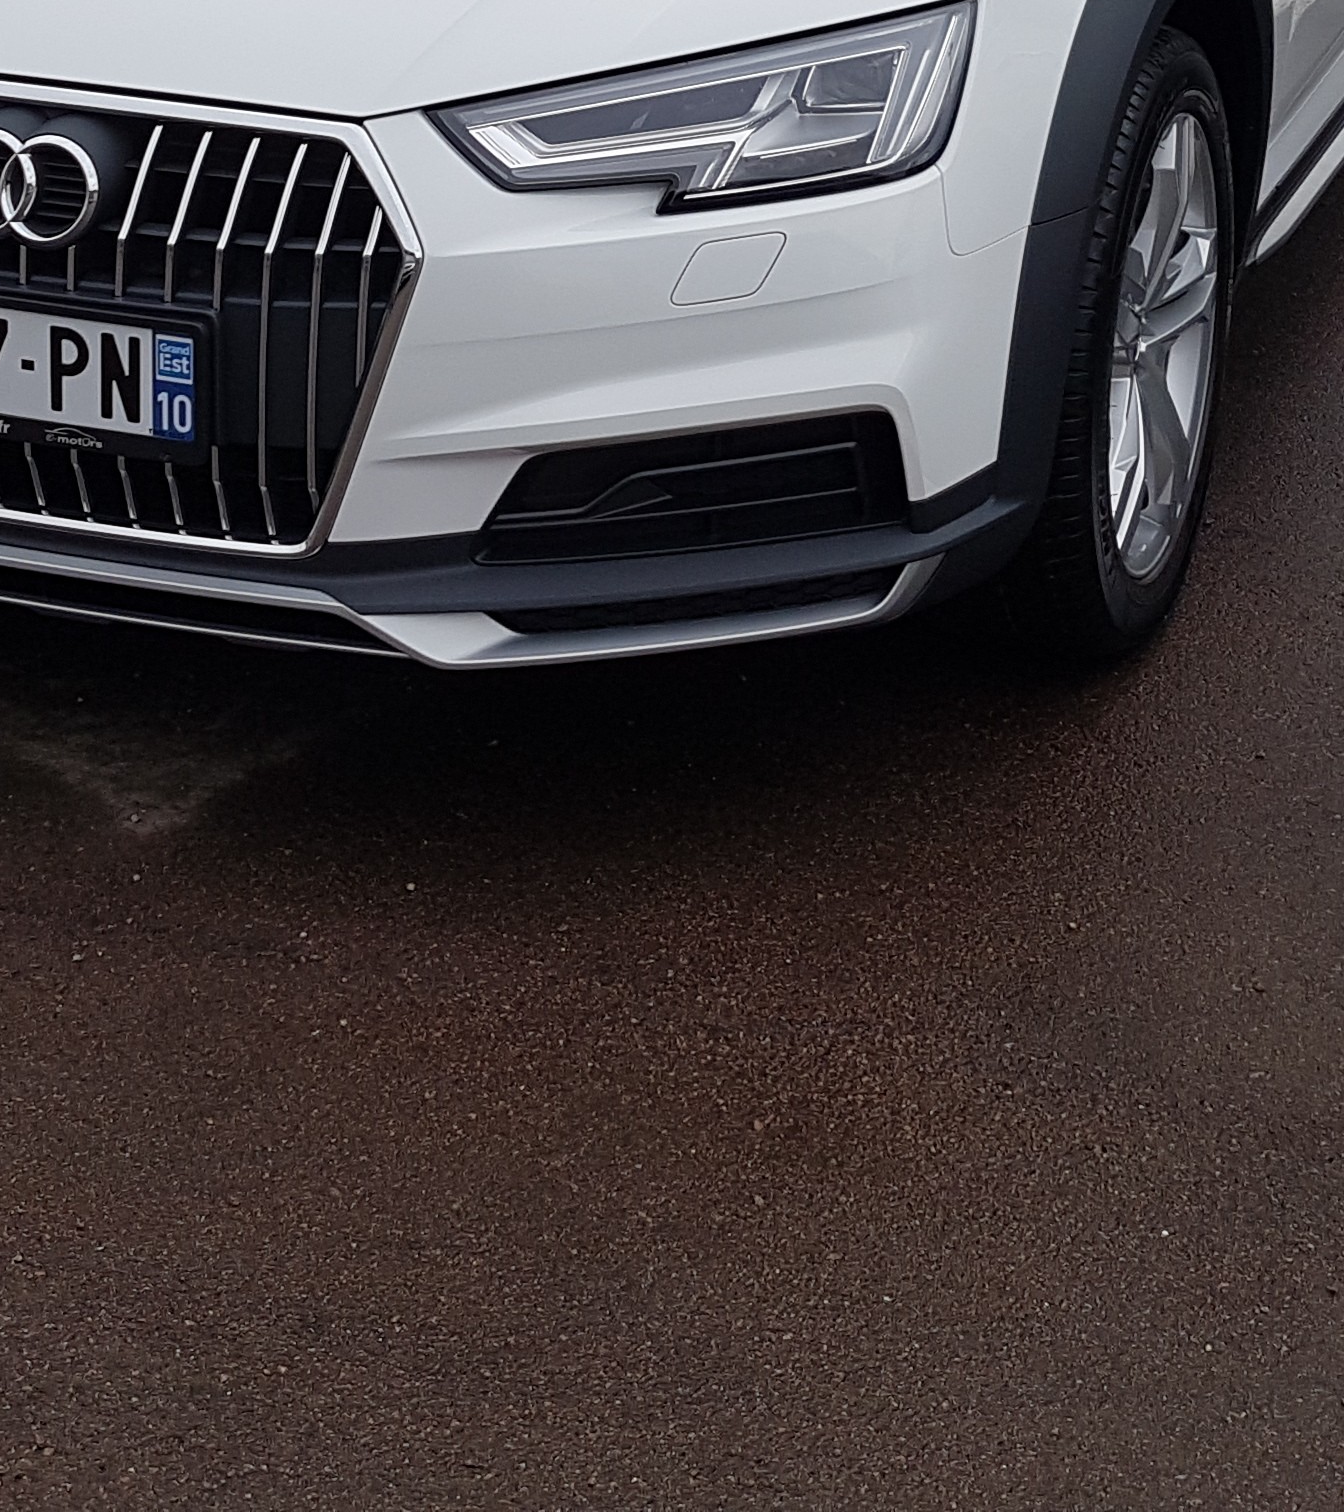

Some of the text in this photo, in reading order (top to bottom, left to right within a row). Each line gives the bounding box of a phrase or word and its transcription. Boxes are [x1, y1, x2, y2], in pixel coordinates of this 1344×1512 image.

[159, 342, 190, 356] Grand
[159, 353, 190, 374] Est
[157, 391, 193, 434] 10
